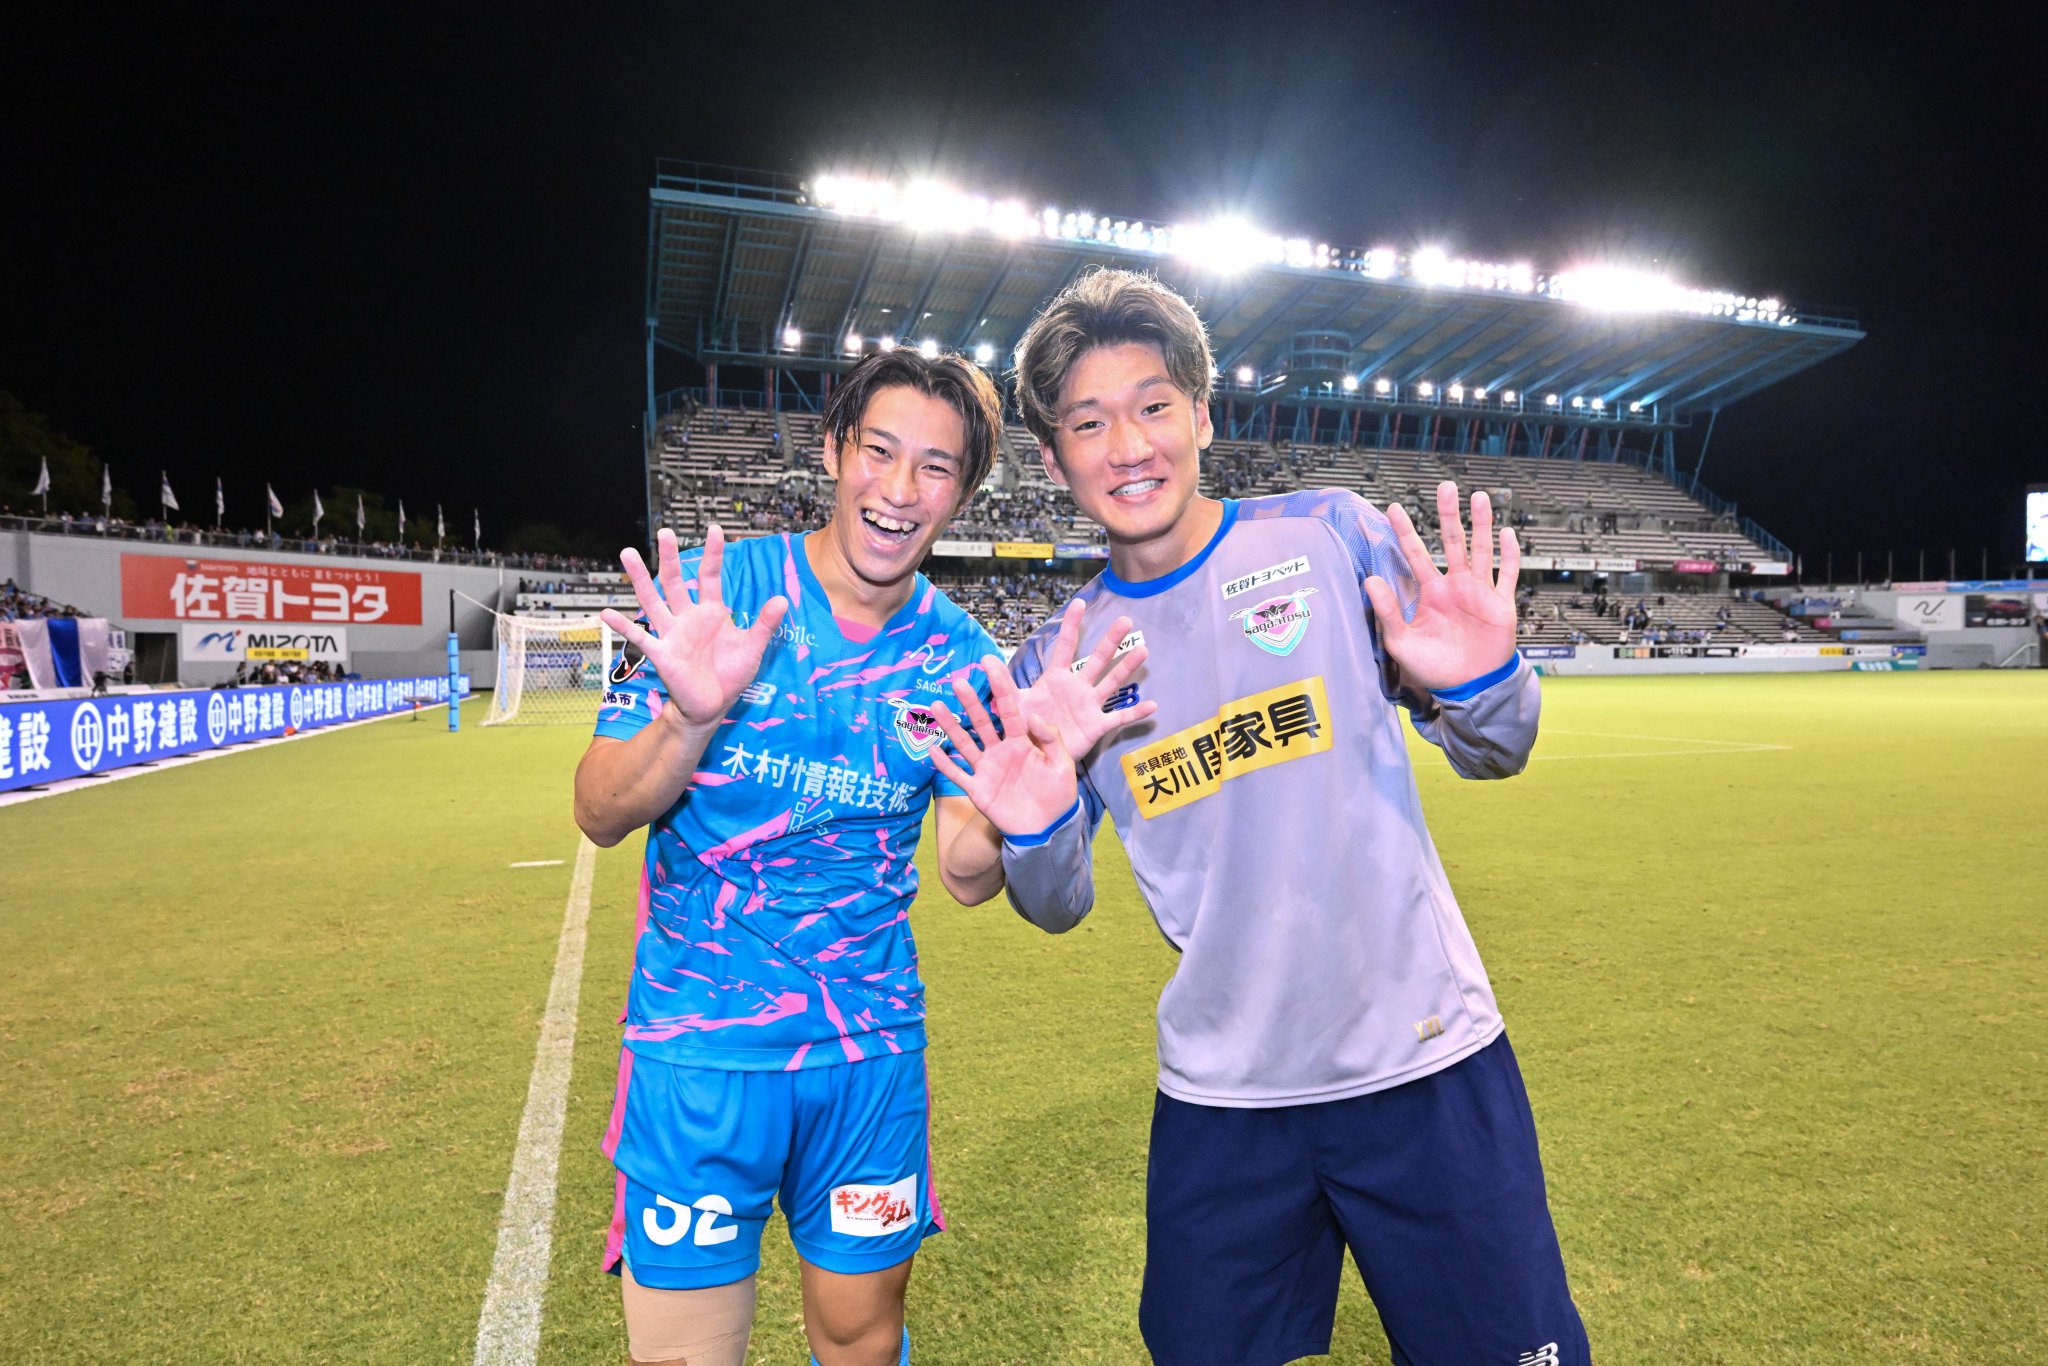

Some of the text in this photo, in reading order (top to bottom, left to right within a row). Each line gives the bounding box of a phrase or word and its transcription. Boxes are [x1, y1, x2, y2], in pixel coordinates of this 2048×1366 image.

[1225, 561, 1305, 596] 佐賀トヨペット
[170, 572, 389, 622] 佐賀トヨタ
[248, 634, 338, 653] MIZOTA
[602, 689, 632, 706] 栖市
[916, 678, 943, 695] SAGA
[106, 698, 198, 758] 中野建設
[228, 692, 285, 737] 中野建設
[721, 742, 917, 813] 木村情報技術
[1133, 746, 1188, 777] 家具産地
[836, 1190, 911, 1227] キングダム
